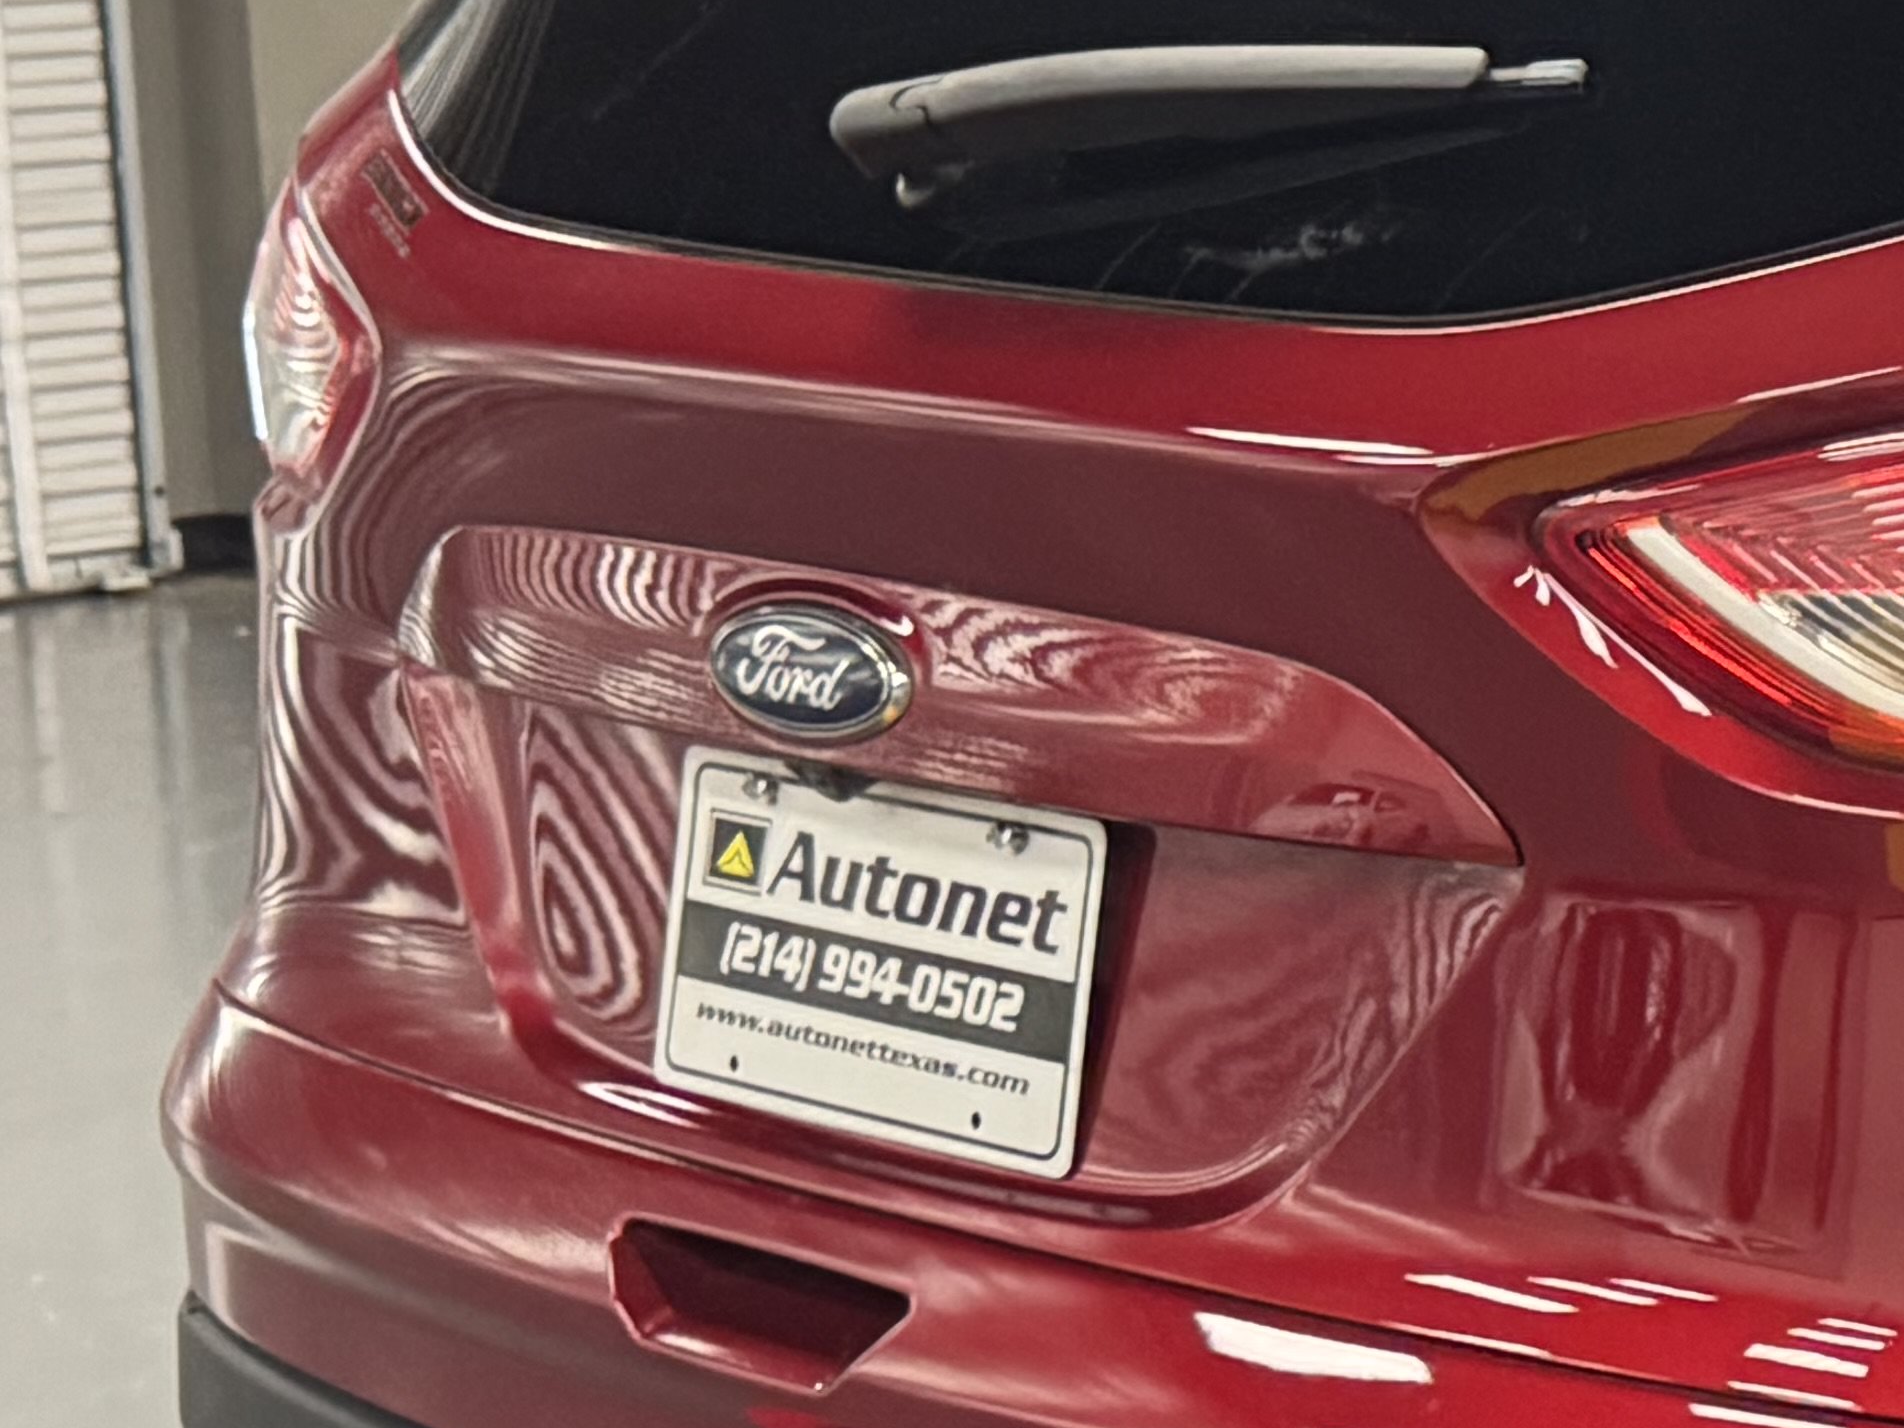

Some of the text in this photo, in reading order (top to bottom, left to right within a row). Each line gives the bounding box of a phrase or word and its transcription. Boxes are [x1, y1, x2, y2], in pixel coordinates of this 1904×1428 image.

[736, 624, 850, 712] Ford
[765, 830, 1069, 956] Autonet
[718, 921, 1026, 1034] (214) 994-0502
[695, 1001, 1031, 1097] www.autonettexas.com
